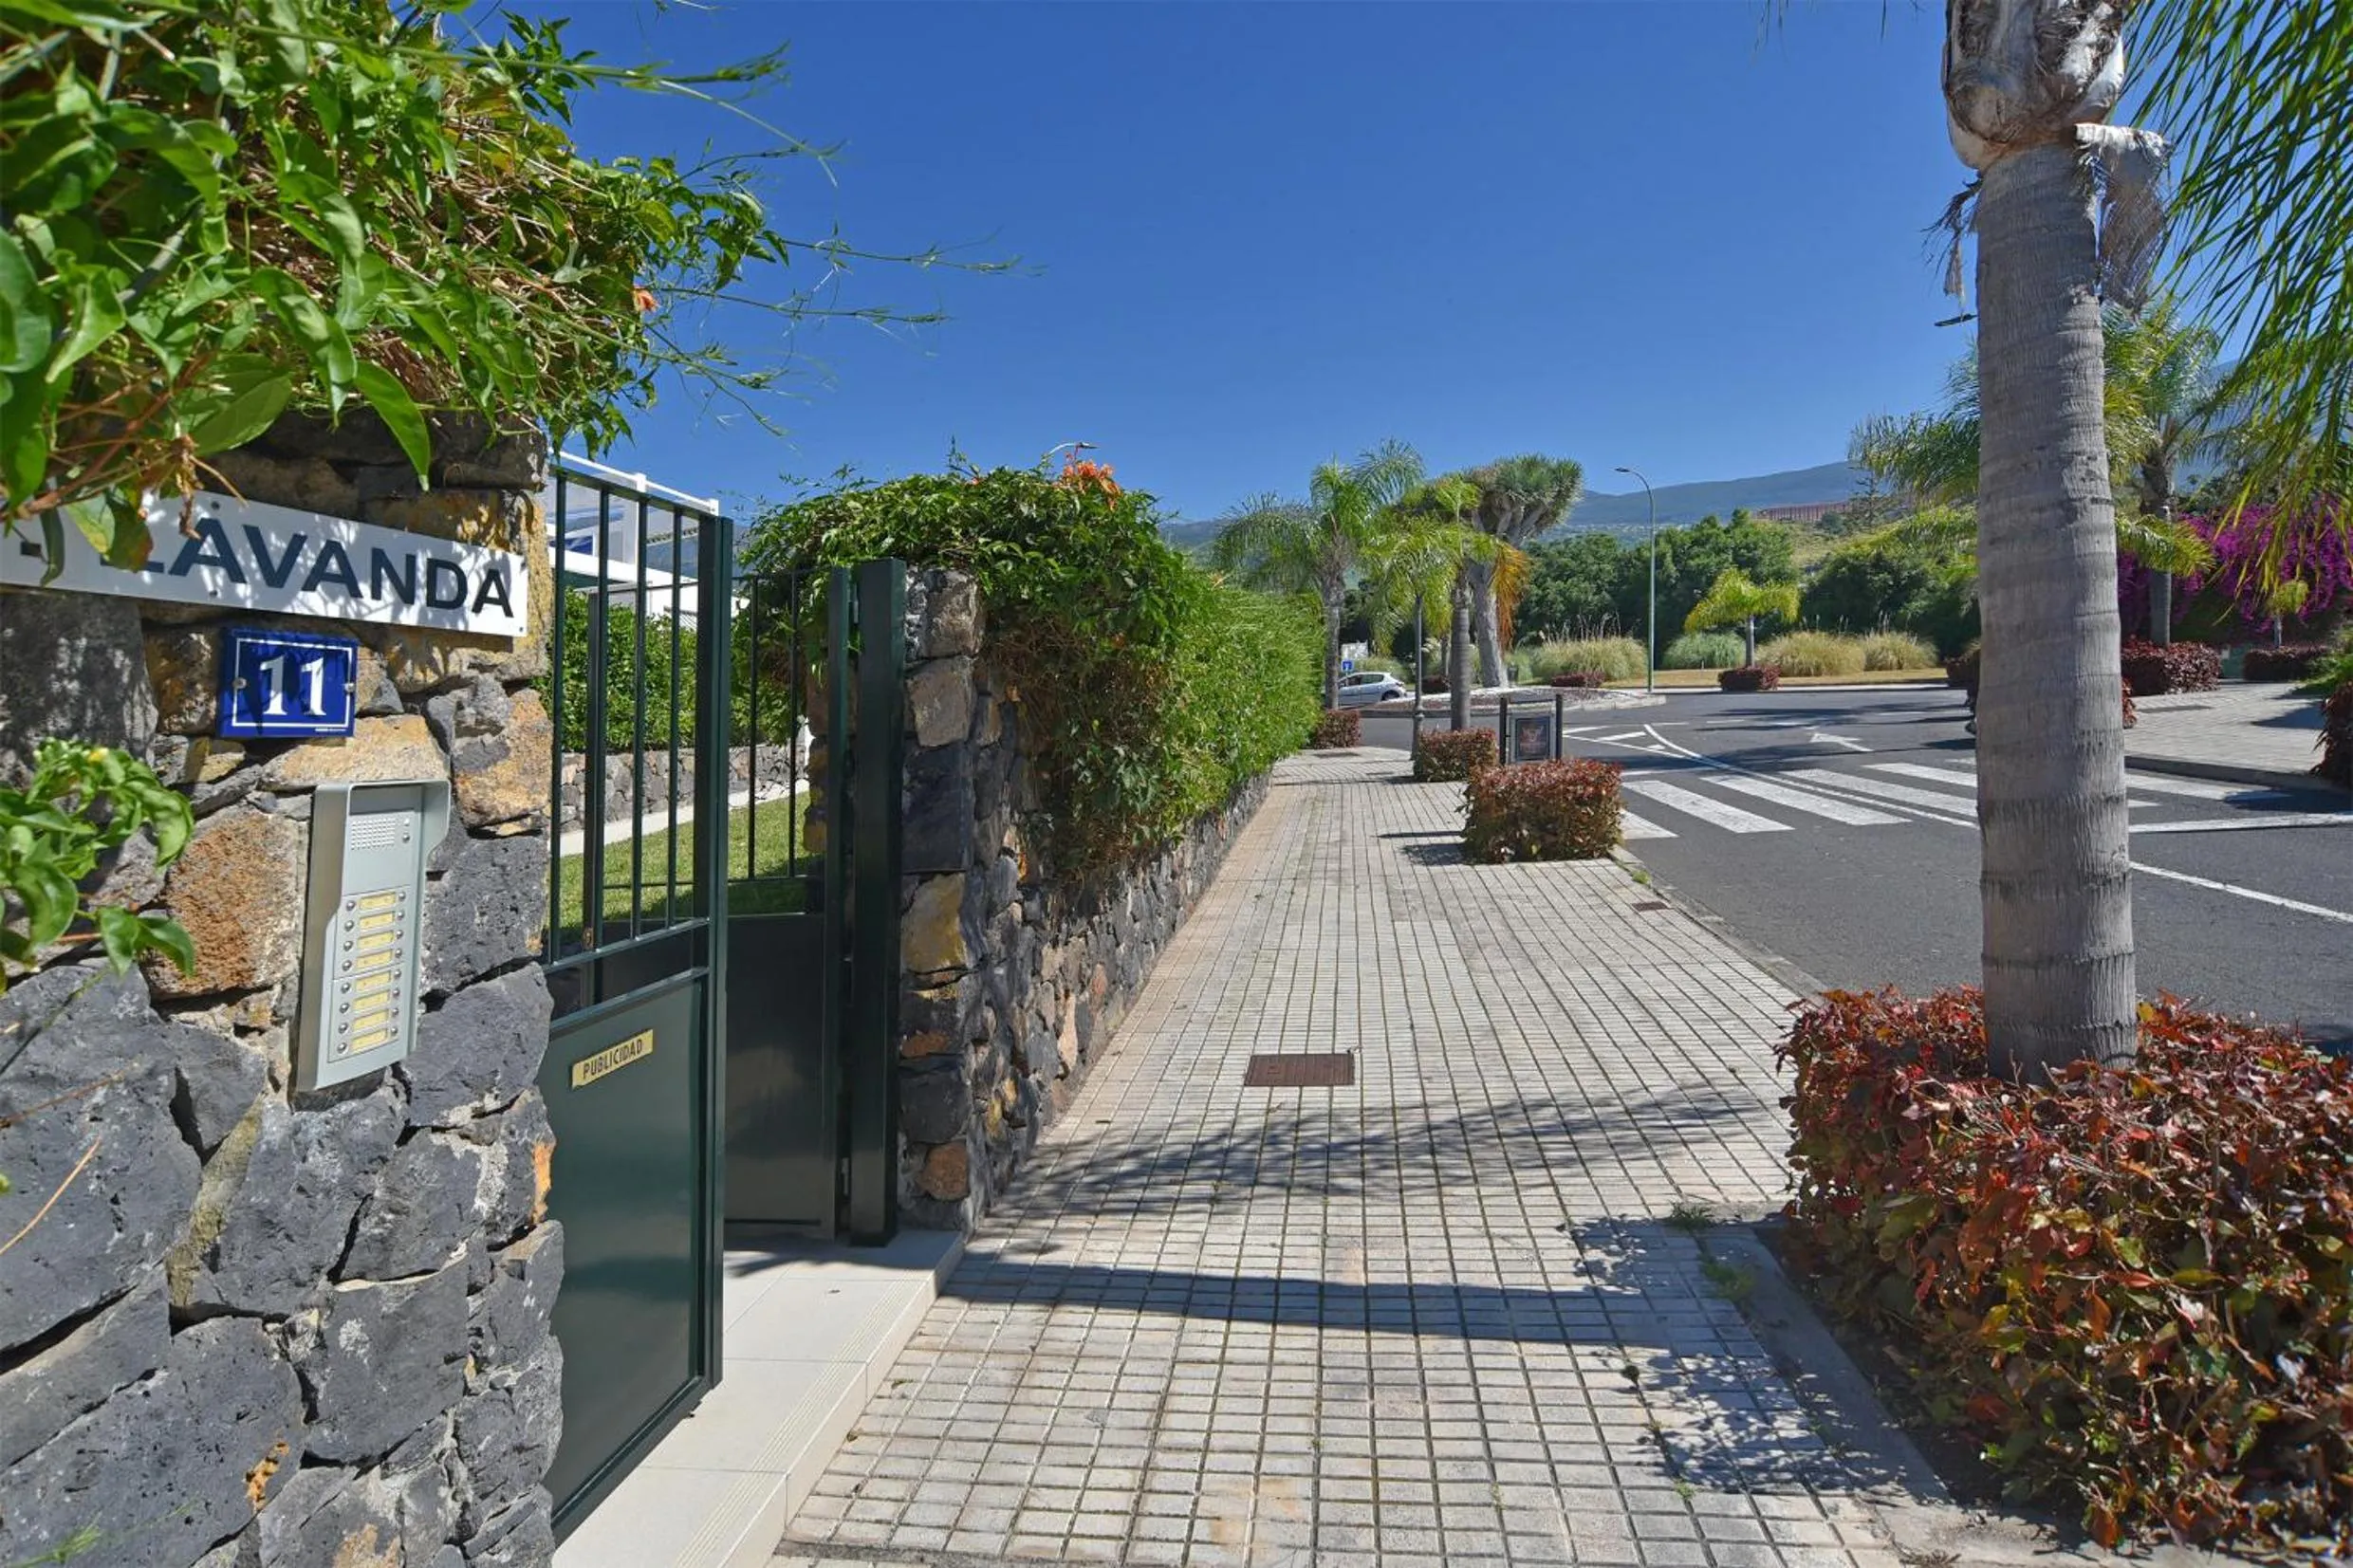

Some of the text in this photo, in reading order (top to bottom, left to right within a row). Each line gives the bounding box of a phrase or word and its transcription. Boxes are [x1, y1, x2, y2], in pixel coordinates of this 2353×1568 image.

[100, 517, 514, 618] AVANDA
[260, 655, 326, 715] 11
[583, 1039, 643, 1079] PUBLICIDAD
